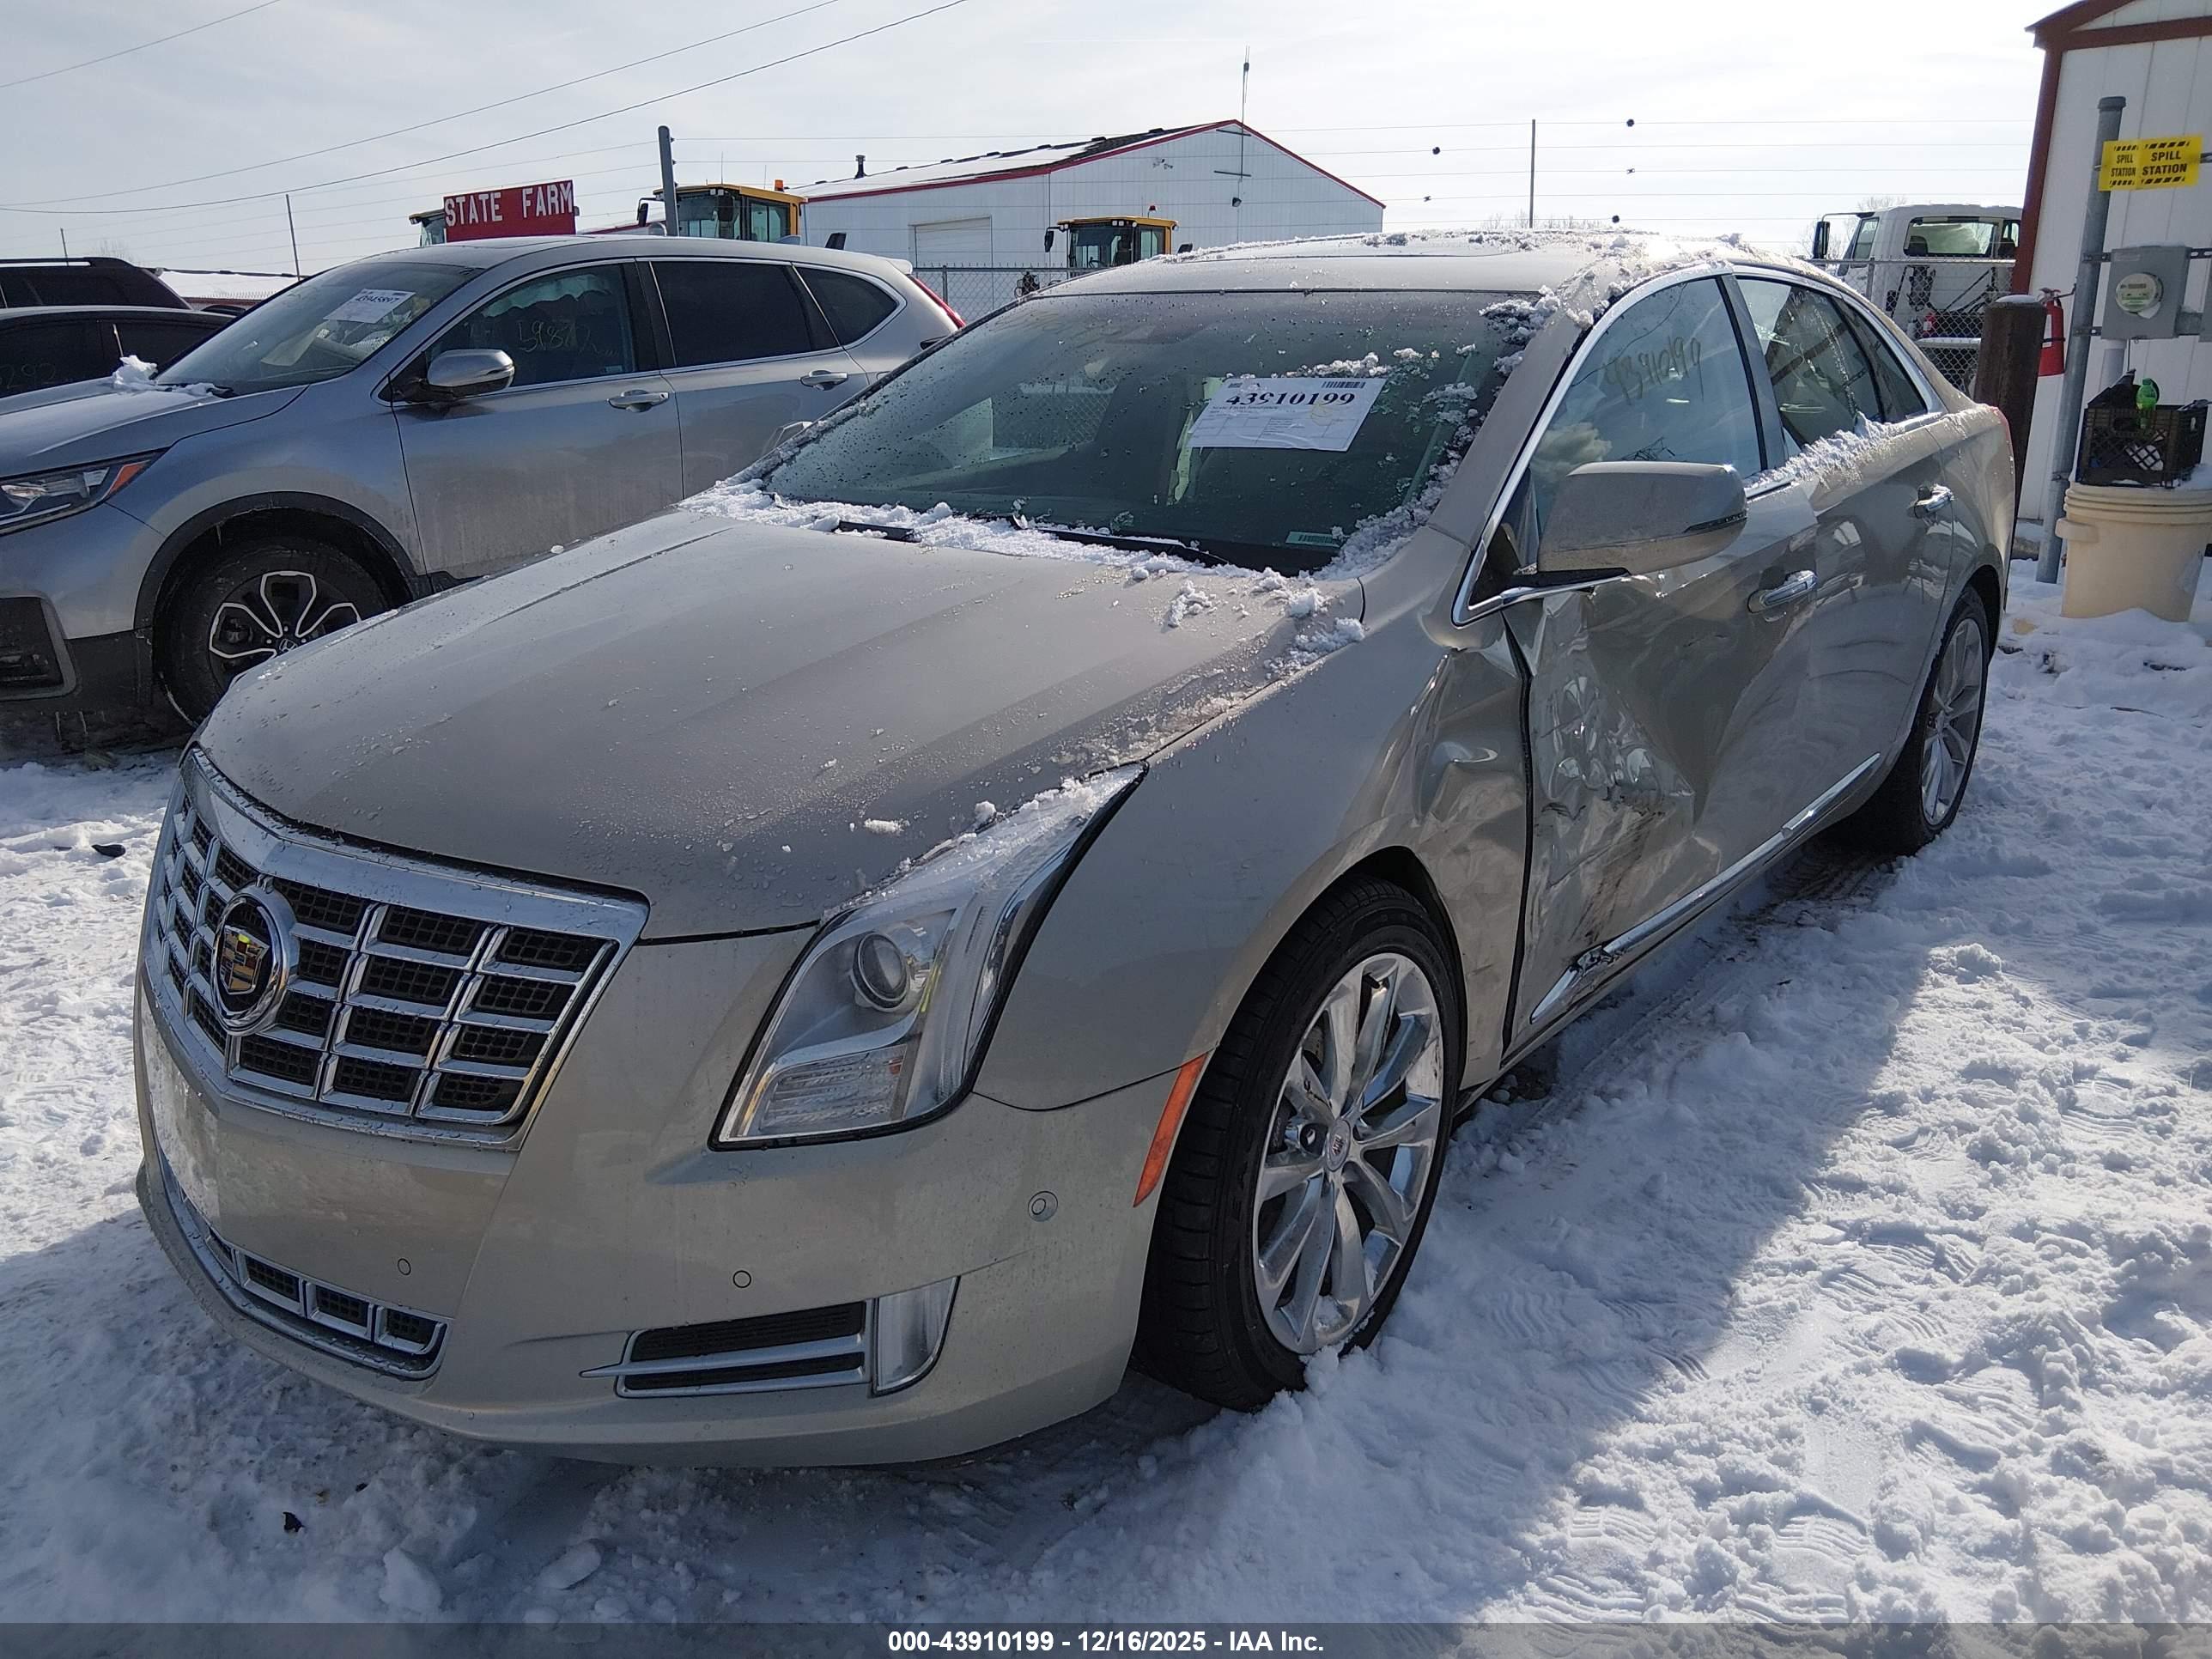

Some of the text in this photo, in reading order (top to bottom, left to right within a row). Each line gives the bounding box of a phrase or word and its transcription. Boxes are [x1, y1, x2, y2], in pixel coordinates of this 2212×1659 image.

[2116, 155, 2134, 164] SPILL
[2150, 150, 2182, 162] SPILL
[2111, 167, 2136, 177] STATION
[2142, 163, 2188, 176] STATION
[444, 181, 573, 227] STATE FARM
[1225, 392, 1356, 406] 43910199
